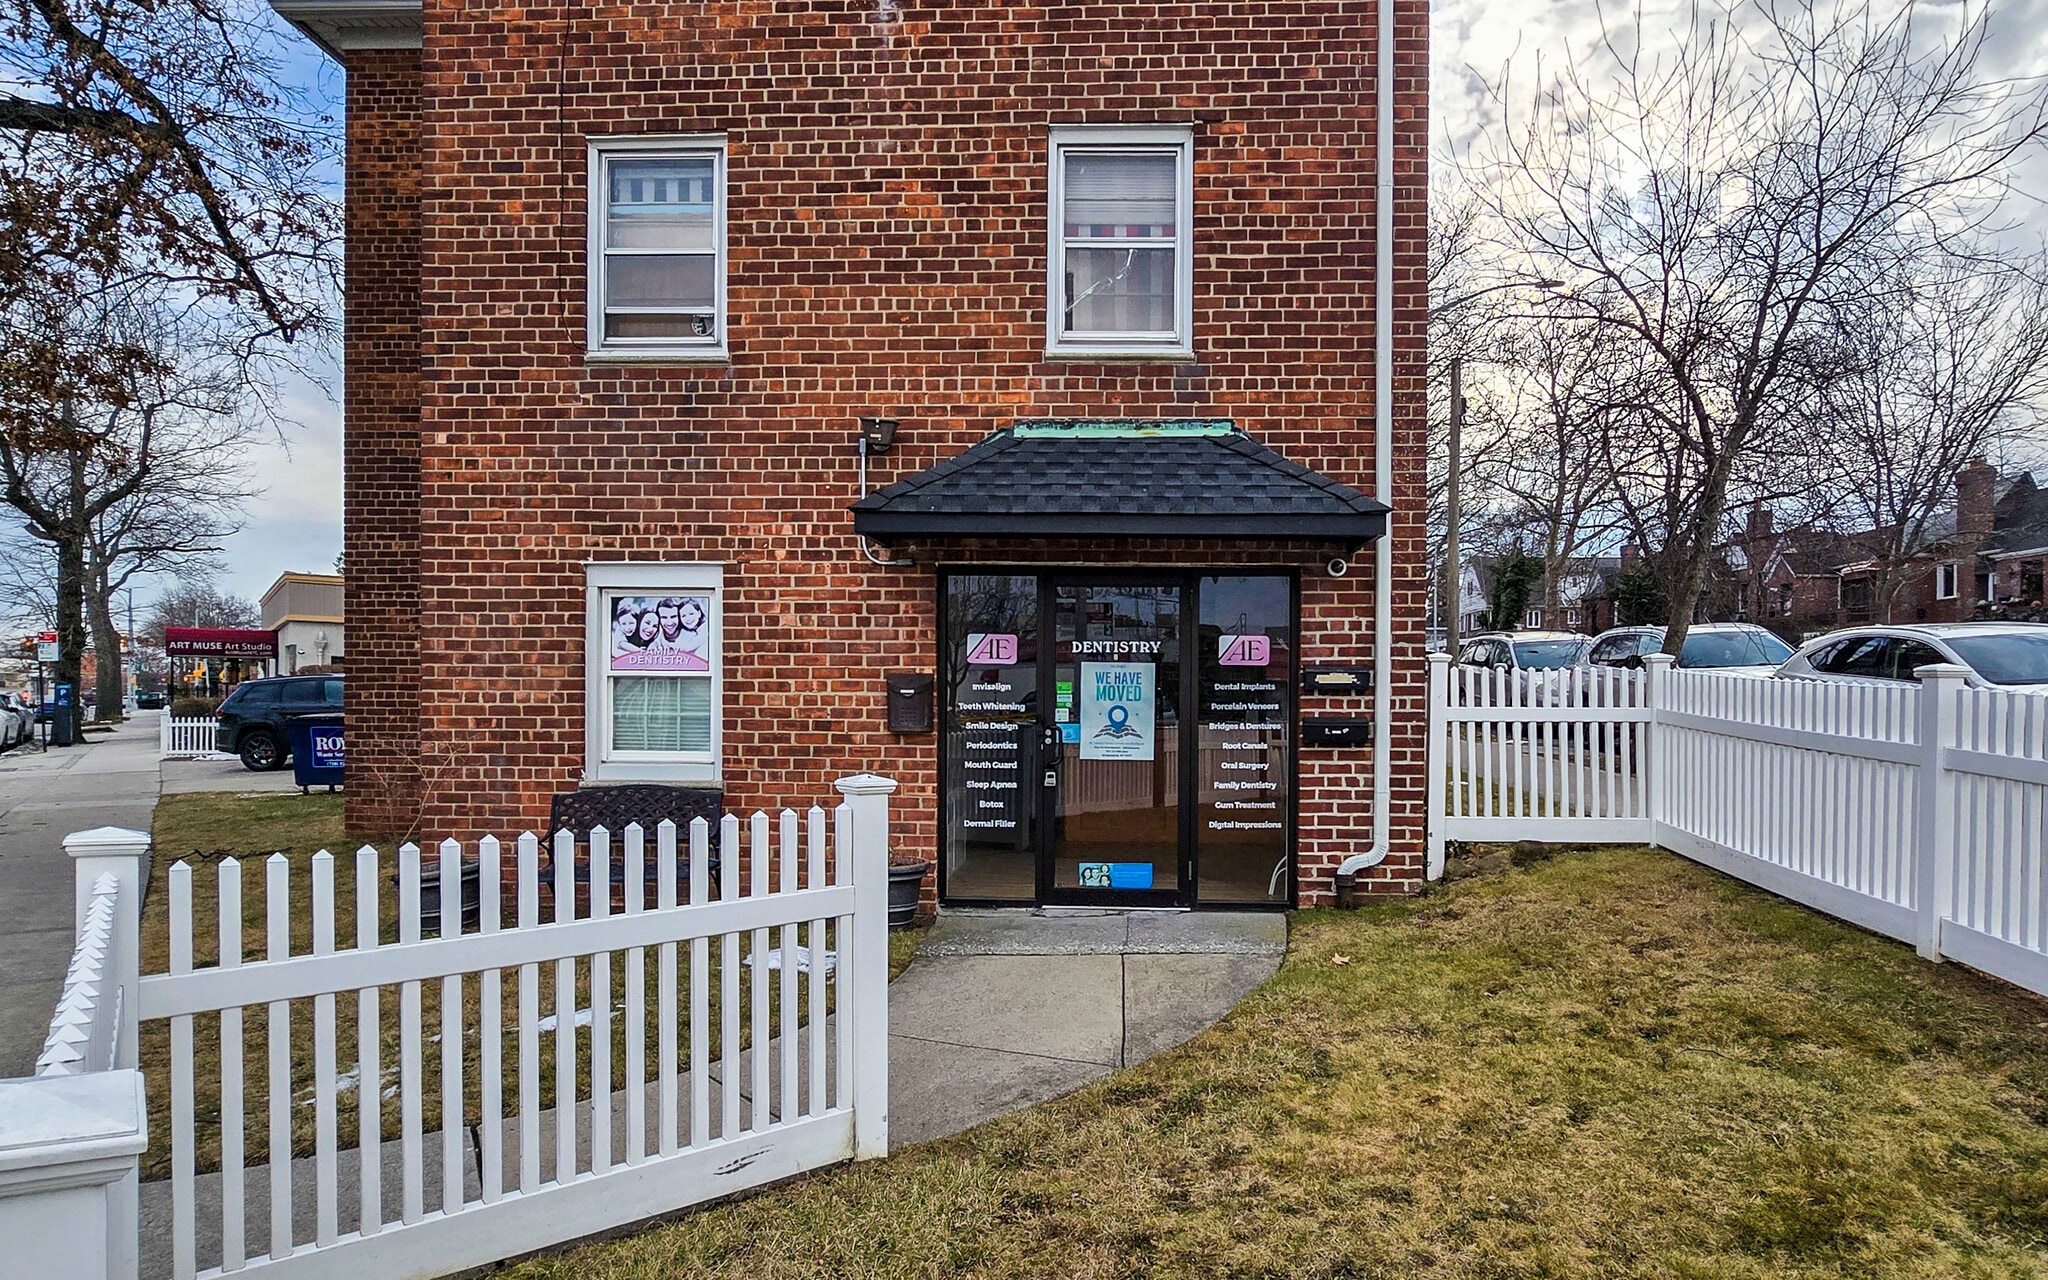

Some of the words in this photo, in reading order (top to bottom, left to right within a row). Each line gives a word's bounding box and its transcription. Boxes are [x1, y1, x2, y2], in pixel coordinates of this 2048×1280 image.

[169, 641, 190, 649] ART
[192, 642, 222, 650] MUSE
[1071, 641, 1161, 654] DENTISTRY
[639, 646, 681, 656] FAMILY
[629, 655, 691, 665] DENTISTRY
[1095, 671, 1112, 685] WE
[1114, 671, 1142, 685] HAVE
[972, 682, 1012, 692] Invisalign
[1241, 683, 1276, 692] Implants
[1096, 685, 1142, 702] MOVED
[958, 702, 981, 710] Teeth
[982, 702, 1026, 712] Whitening
[1211, 702, 1247, 710] Porcelain
[1247, 702, 1279, 710] Veneers
[965, 721, 989, 730] Smile
[990, 721, 1019, 731] Design
[1209, 722, 1239, 731] Bridges
[1239, 722, 1245, 730] &
[1246, 722, 1281, 730] Dentures
[966, 741, 1018, 749] Periodontics
[964, 760, 991, 769] Mouth
[992, 760, 1018, 769] Guard
[1221, 761, 1238, 769] Oral
[1238, 762, 1269, 771] Surgery
[966, 780, 989, 790] Sleep
[990, 781, 1018, 790] Apnea
[1213, 781, 1240, 790] Family
[1240, 781, 1277, 790] Dentistry
[979, 800, 1004, 808] Botox
[1215, 801, 1234, 809] Gum
[1234, 801, 1276, 809] Treatment
[963, 819, 994, 828] Dermal
[995, 819, 1016, 828] Filler
[1208, 821, 1234, 830] Digital
[1235, 821, 1282, 830] Impressions
